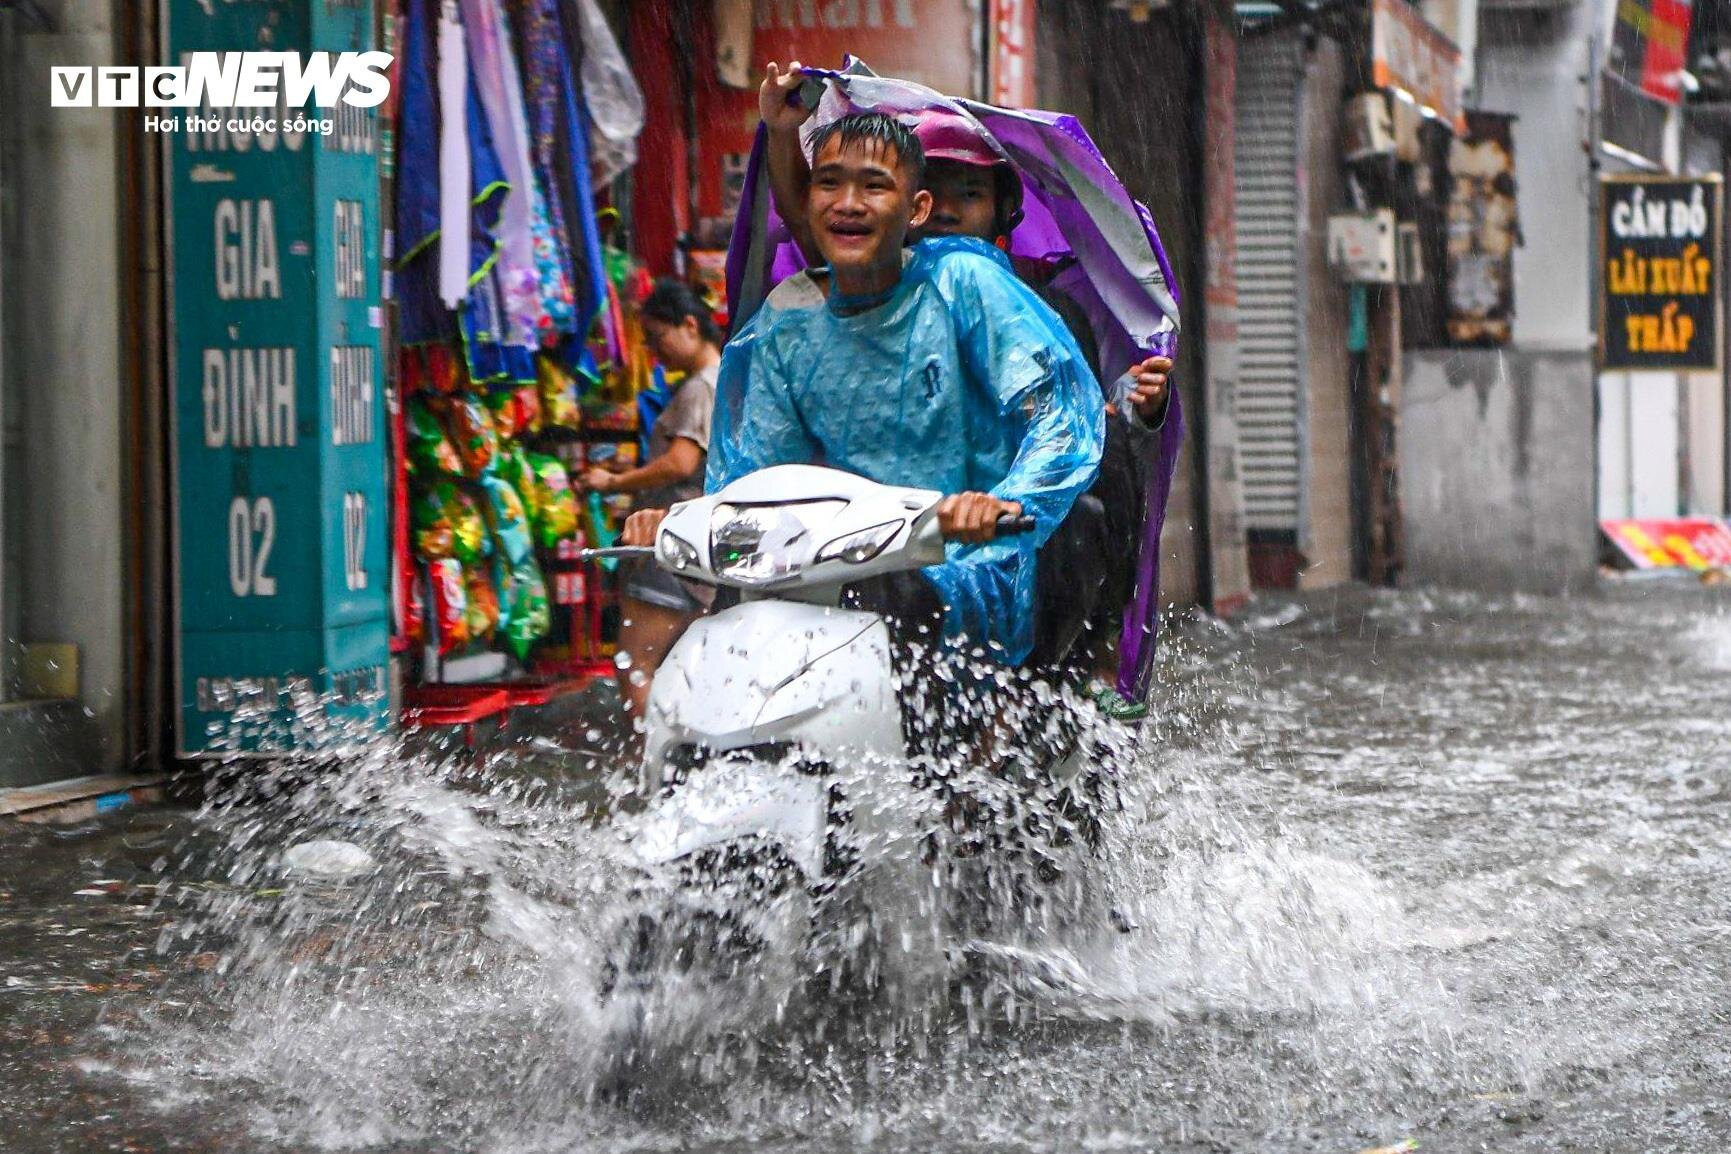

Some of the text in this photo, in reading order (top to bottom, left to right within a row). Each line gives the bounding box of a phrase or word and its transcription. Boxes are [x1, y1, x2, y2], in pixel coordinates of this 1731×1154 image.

[212, 198, 281, 299] GIA
[1626, 301, 1695, 353] THẤP
[229, 497, 277, 597] 02
